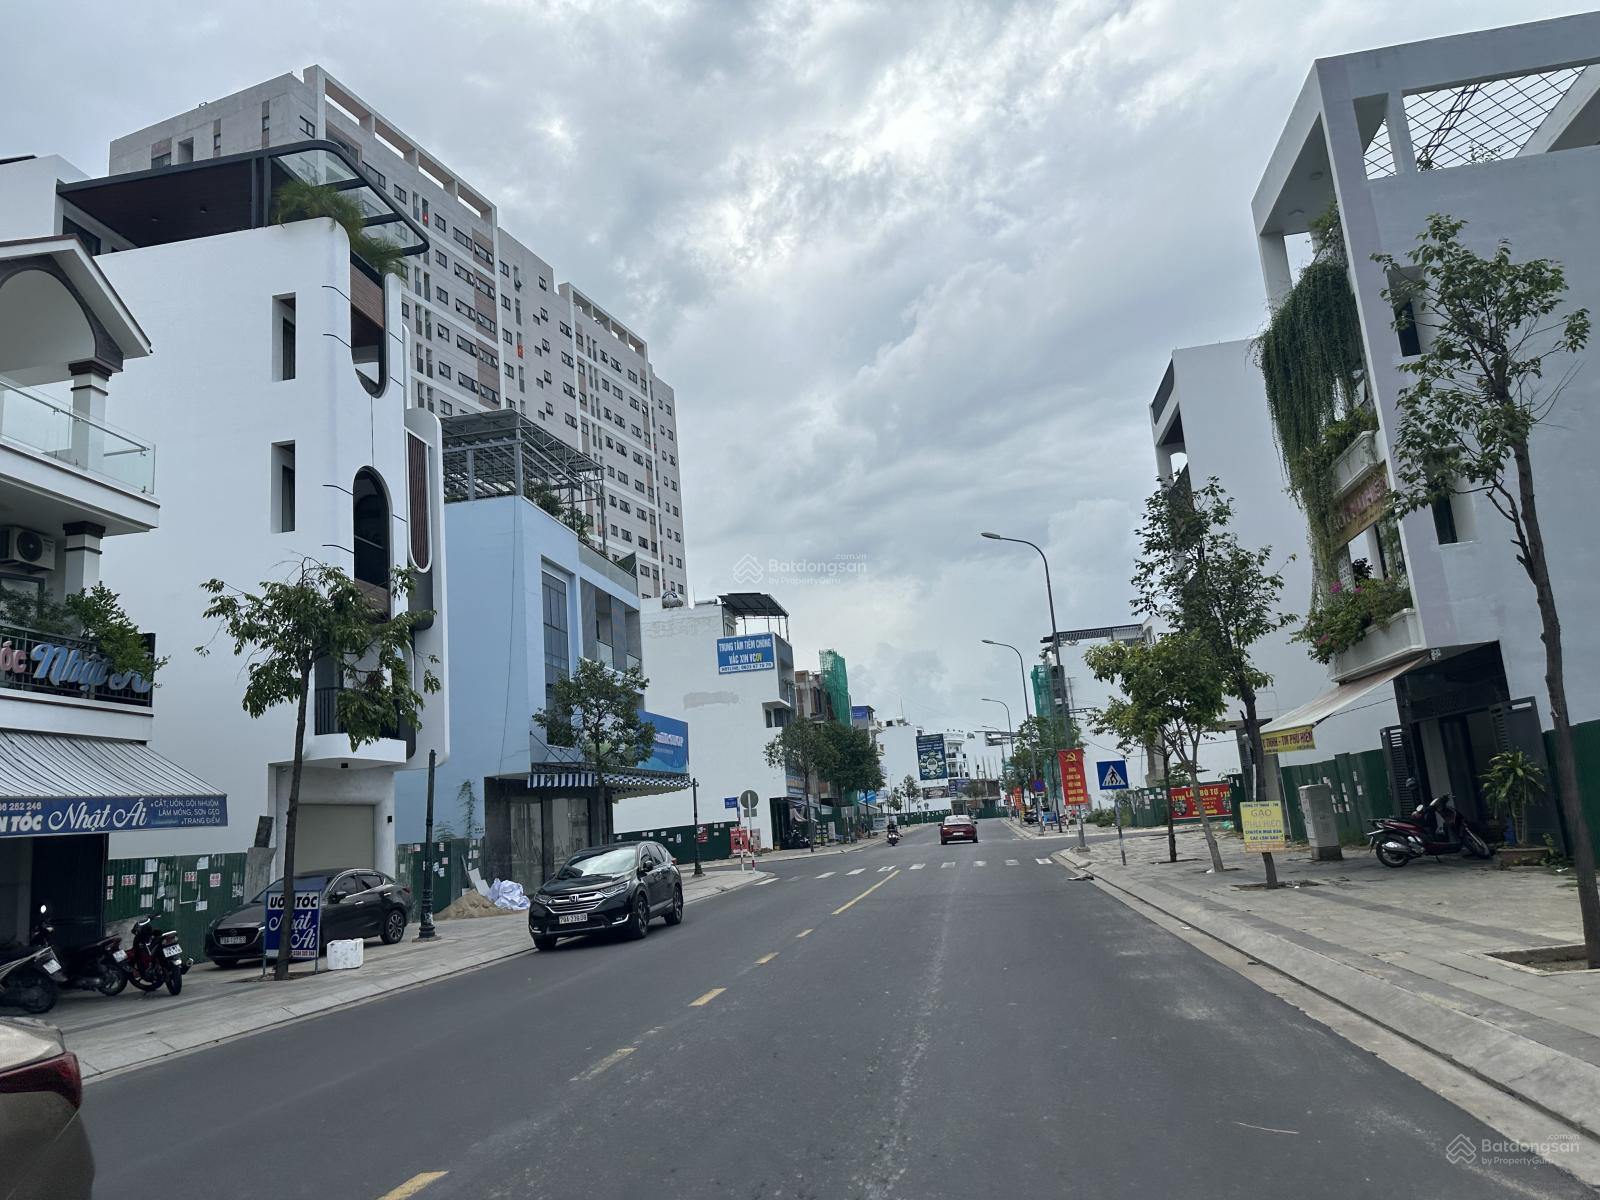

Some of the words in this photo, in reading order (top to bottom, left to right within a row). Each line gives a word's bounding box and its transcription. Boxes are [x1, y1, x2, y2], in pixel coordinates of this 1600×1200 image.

[11, 811, 43, 832] TÓC
[48, 801, 111, 831] Nhật
[113, 798, 149, 828] Ái
[296, 893, 317, 908] TÓC
[290, 925, 316, 949] Ái
